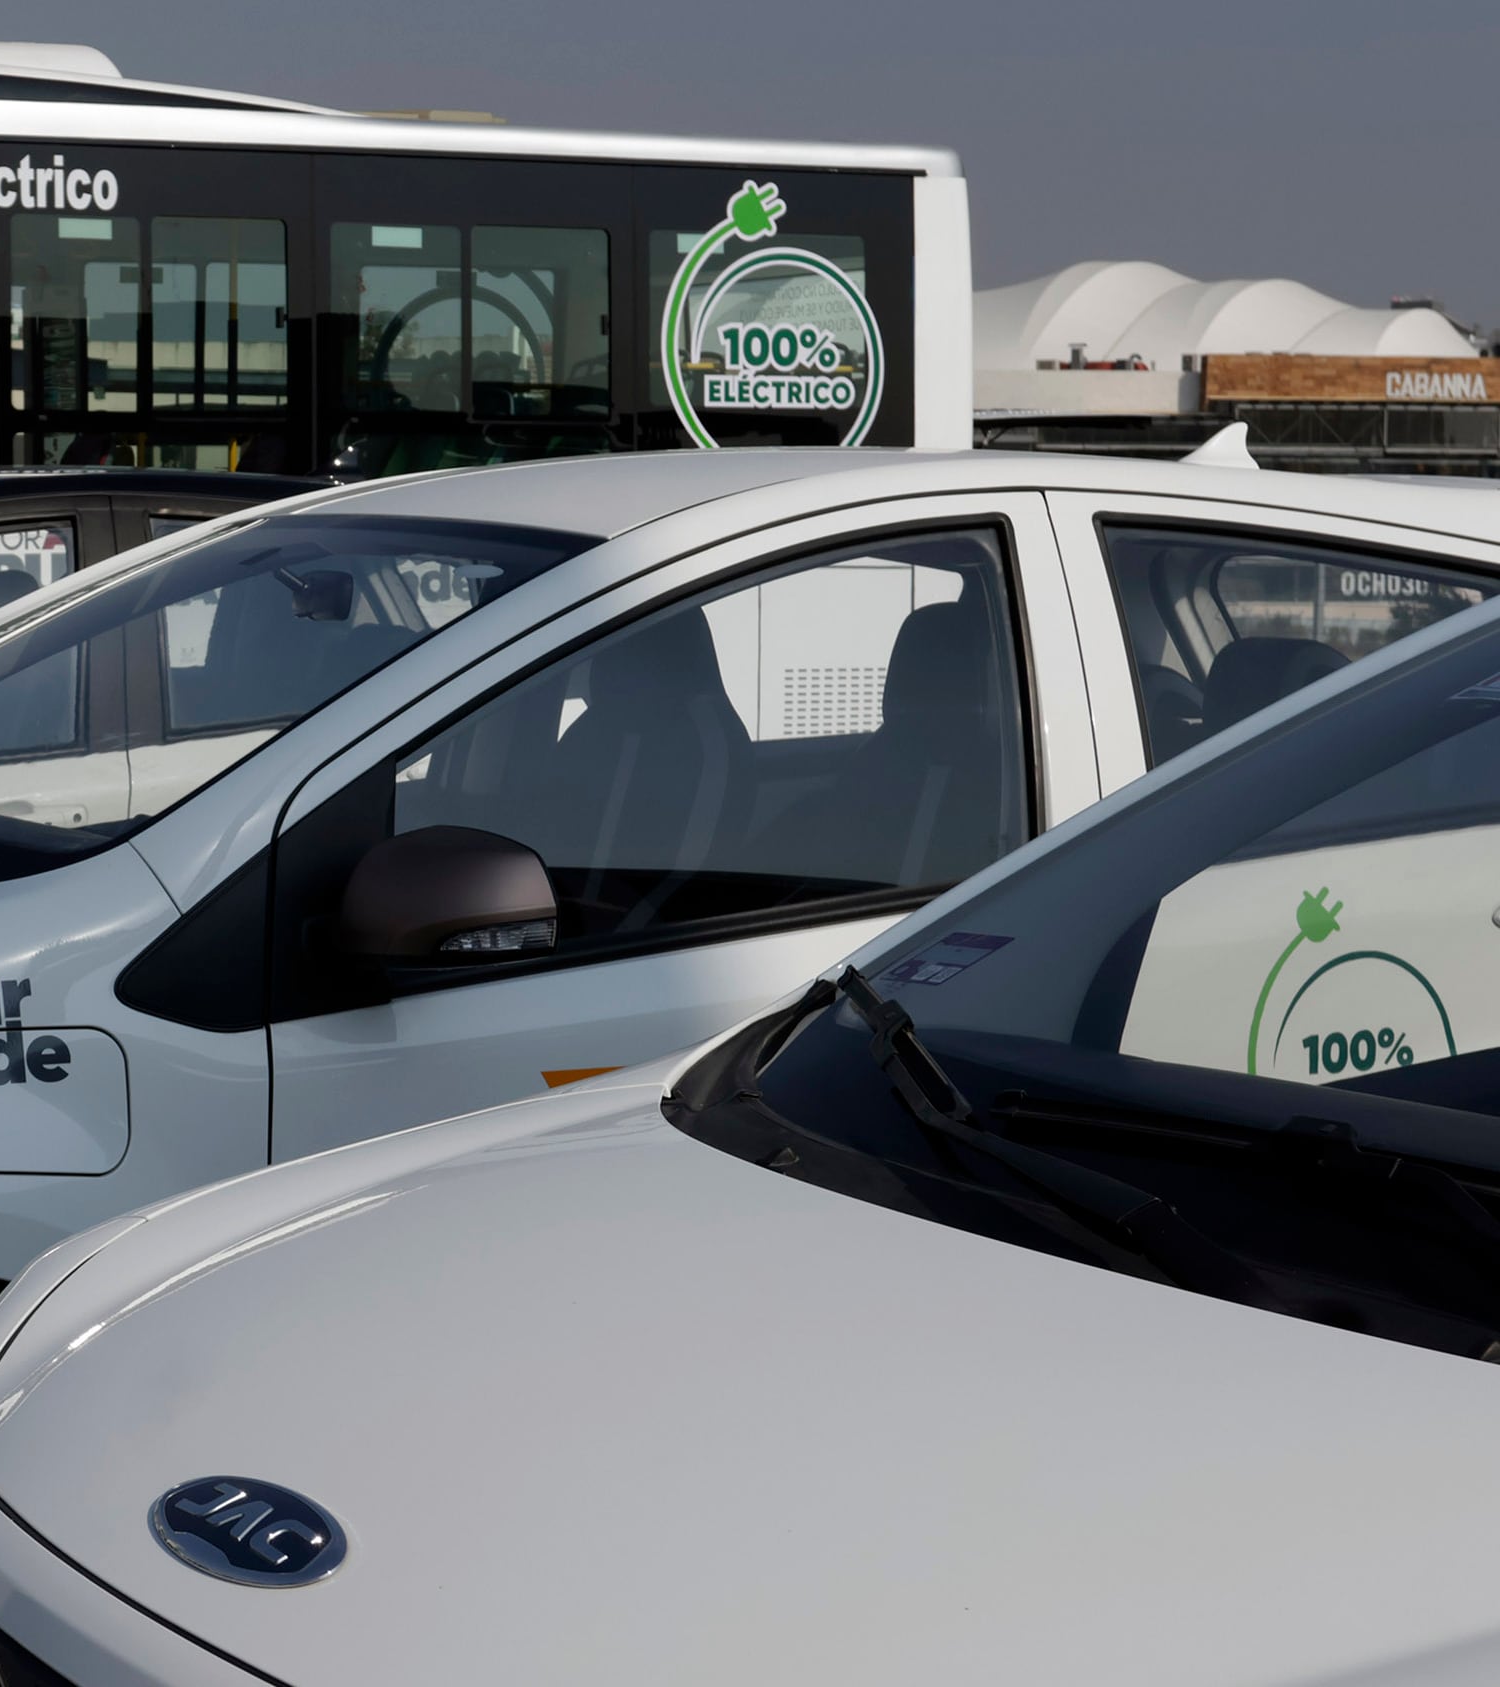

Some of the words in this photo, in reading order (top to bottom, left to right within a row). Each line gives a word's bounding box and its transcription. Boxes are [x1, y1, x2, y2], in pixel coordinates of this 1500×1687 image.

[723, 327, 836, 367] 100%
[708, 374, 851, 404] ELÉCTRICO
[1385, 371, 1488, 401] CABANNA
[1302, 1027, 1414, 1075] 100%
[175, 1482, 323, 1566] JAC
